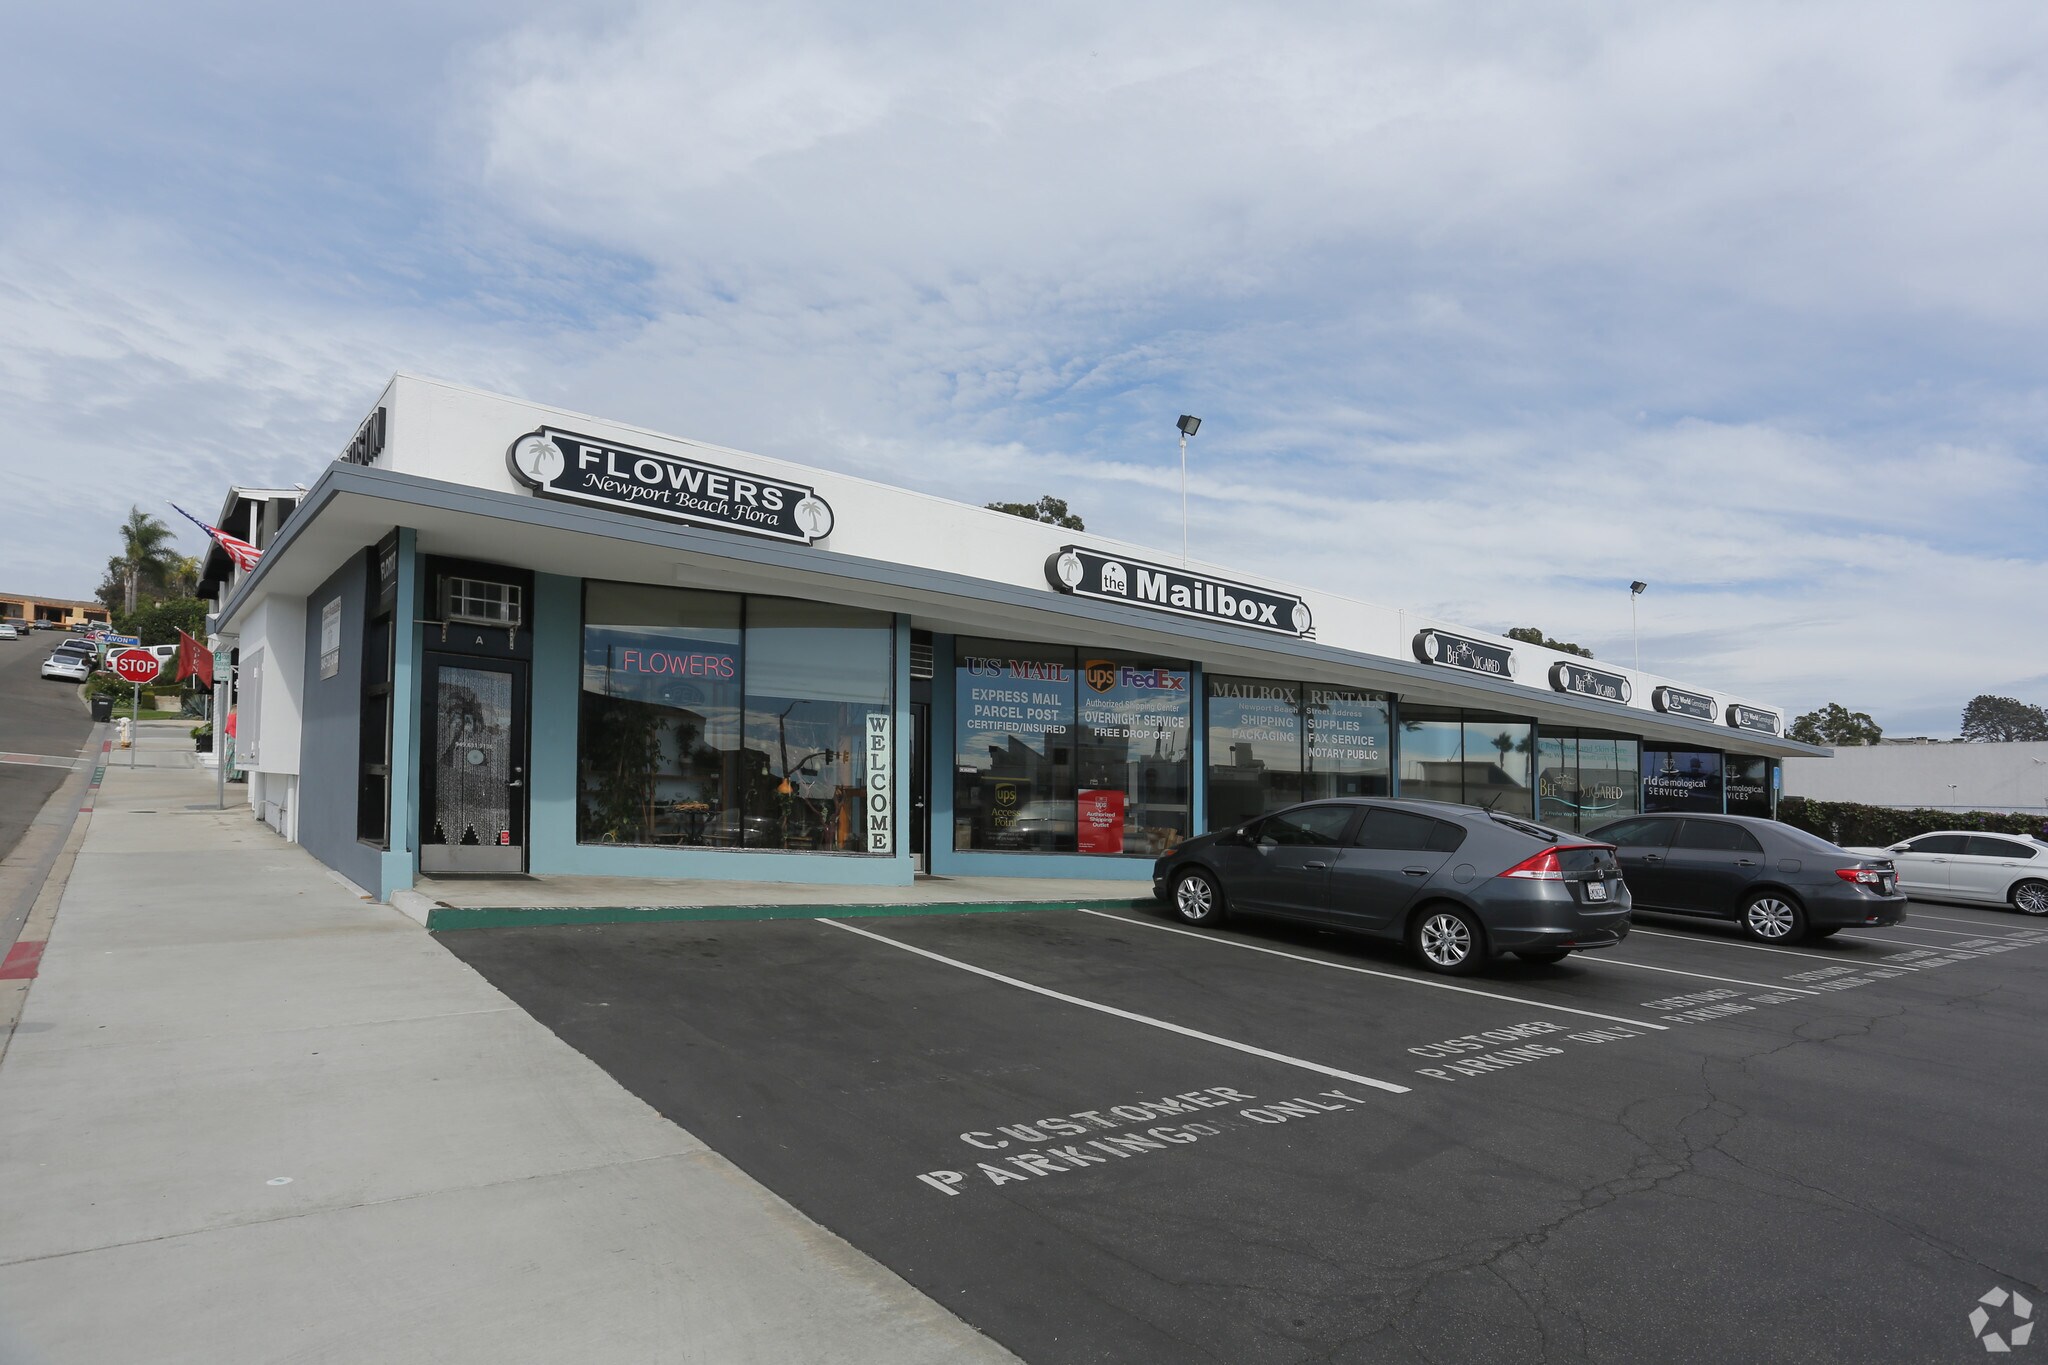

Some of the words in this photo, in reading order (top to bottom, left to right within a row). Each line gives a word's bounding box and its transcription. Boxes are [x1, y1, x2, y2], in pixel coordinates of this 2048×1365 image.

[579, 445, 783, 511] FLOWERS
[583, 473, 670, 503] Newport
[676, 492, 730, 516] Beach
[731, 504, 779, 526] Flora
[1103, 574, 1124, 591] the
[1137, 569, 1278, 625] Mailbox
[107, 635, 128, 643] AVON
[475, 635, 483, 645] A
[119, 658, 157, 673] STOP
[191, 646, 200, 675] OPEN
[624, 651, 734, 678] FLOWERS
[965, 656, 1001, 678] US
[1009, 660, 1069, 682] MAIL
[1121, 666, 1185, 691] FedEx
[972, 688, 1028, 704] EXPRESS
[1033, 693, 1062, 705] MAIL
[1213, 682, 1296, 703] MAILBOX
[1311, 690, 1384, 709] RENTALS
[974, 705, 1023, 718] PARCEL
[1027, 708, 1059, 720] POST
[1085, 698, 1124, 708] Authorized
[1125, 700, 1155, 712] Shipping
[1156, 704, 1180, 712] Center
[1238, 703, 1271, 712] Newport
[1273, 705, 1298, 714] Beach
[1306, 707, 1330, 716] Street
[1332, 709, 1362, 718] Address
[967, 719, 1066, 734] CERTIFIED/INSURED
[1084, 711, 1141, 725] OVERNIGHT
[1144, 715, 1184, 728] SERVICE
[1241, 714, 1294, 728] SHIPPING
[1308, 718, 1360, 731] SUPPLIES
[1094, 728, 1120, 738] FREE
[1123, 729, 1150, 739] DROP
[1153, 731, 1171, 740] OFF
[1231, 730, 1295, 743] PACKAGING
[1308, 733, 1328, 744] FAX
[1331, 734, 1374, 746] SERVICE
[1308, 747, 1344, 759] NOTARY
[1347, 750, 1378, 760] PUBLIC
[868, 716, 888, 850] WELCOME
[1643, 776, 1657, 786] rld
[1659, 778, 1706, 789] Gemological
[1648, 787, 1689, 798] SERVICES
[991, 807, 1021, 816] Access
[995, 817, 1017, 827] Point
[1408, 1021, 1571, 1059] CUSTOMER
[1414, 1043, 1566, 1082] PARKING
[1568, 1026, 1647, 1045] ONLY
[960, 1087, 1256, 1149] CUSTOMER
[916, 1126, 1198, 1196] PARKING
[1240, 1089, 1366, 1124] ONLY
